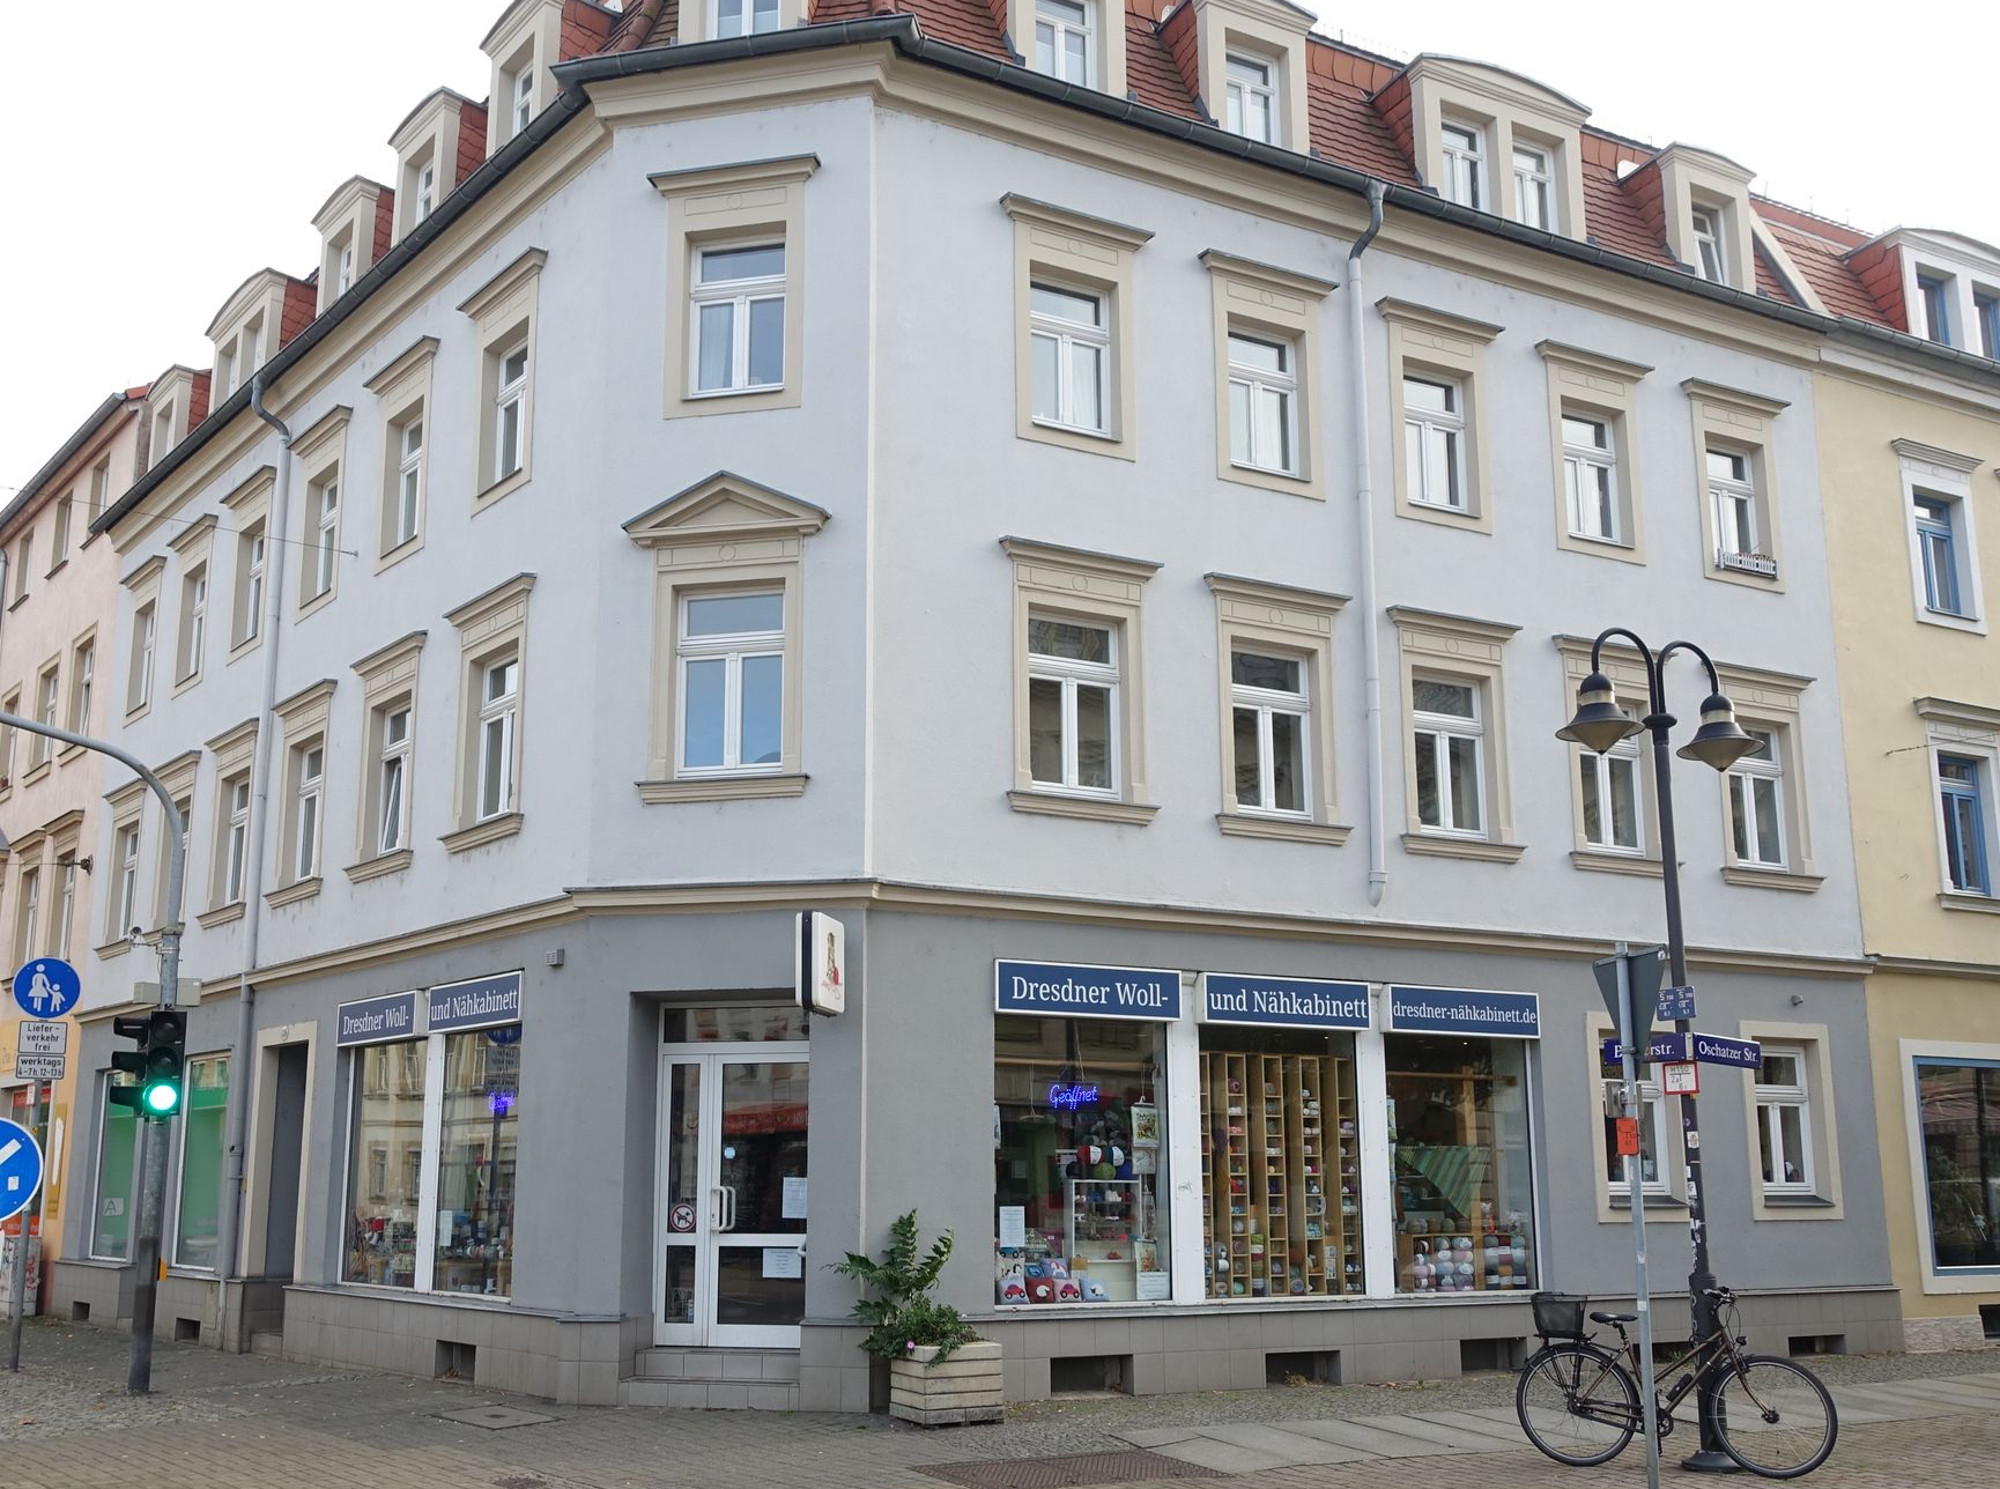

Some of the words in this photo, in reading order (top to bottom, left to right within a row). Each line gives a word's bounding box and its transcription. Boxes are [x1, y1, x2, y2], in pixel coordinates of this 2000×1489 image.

[1012, 976, 1110, 1004] Dresdner
[1115, 982, 1168, 1007] Woll-
[1209, 989, 1248, 1012] und
[1253, 991, 1367, 1018] Nähkabinett
[431, 998, 450, 1021] und
[452, 989, 518, 1018] Nähkabinett
[1393, 1001, 1537, 1024] dresdner-nähkabinett.de
[343, 1012, 383, 1035] Dresdner
[386, 1005, 408, 1027] Woll-
[26, 1034, 59, 1042] verkehr
[35, 1043, 51, 1051] frei
[20, 1057, 62, 1067] werktags
[1698, 1041, 1742, 1060] Oschatzer
[1744, 1048, 1759, 1062] Str.
[1050, 1084, 1097, 1110] Geöffnet
